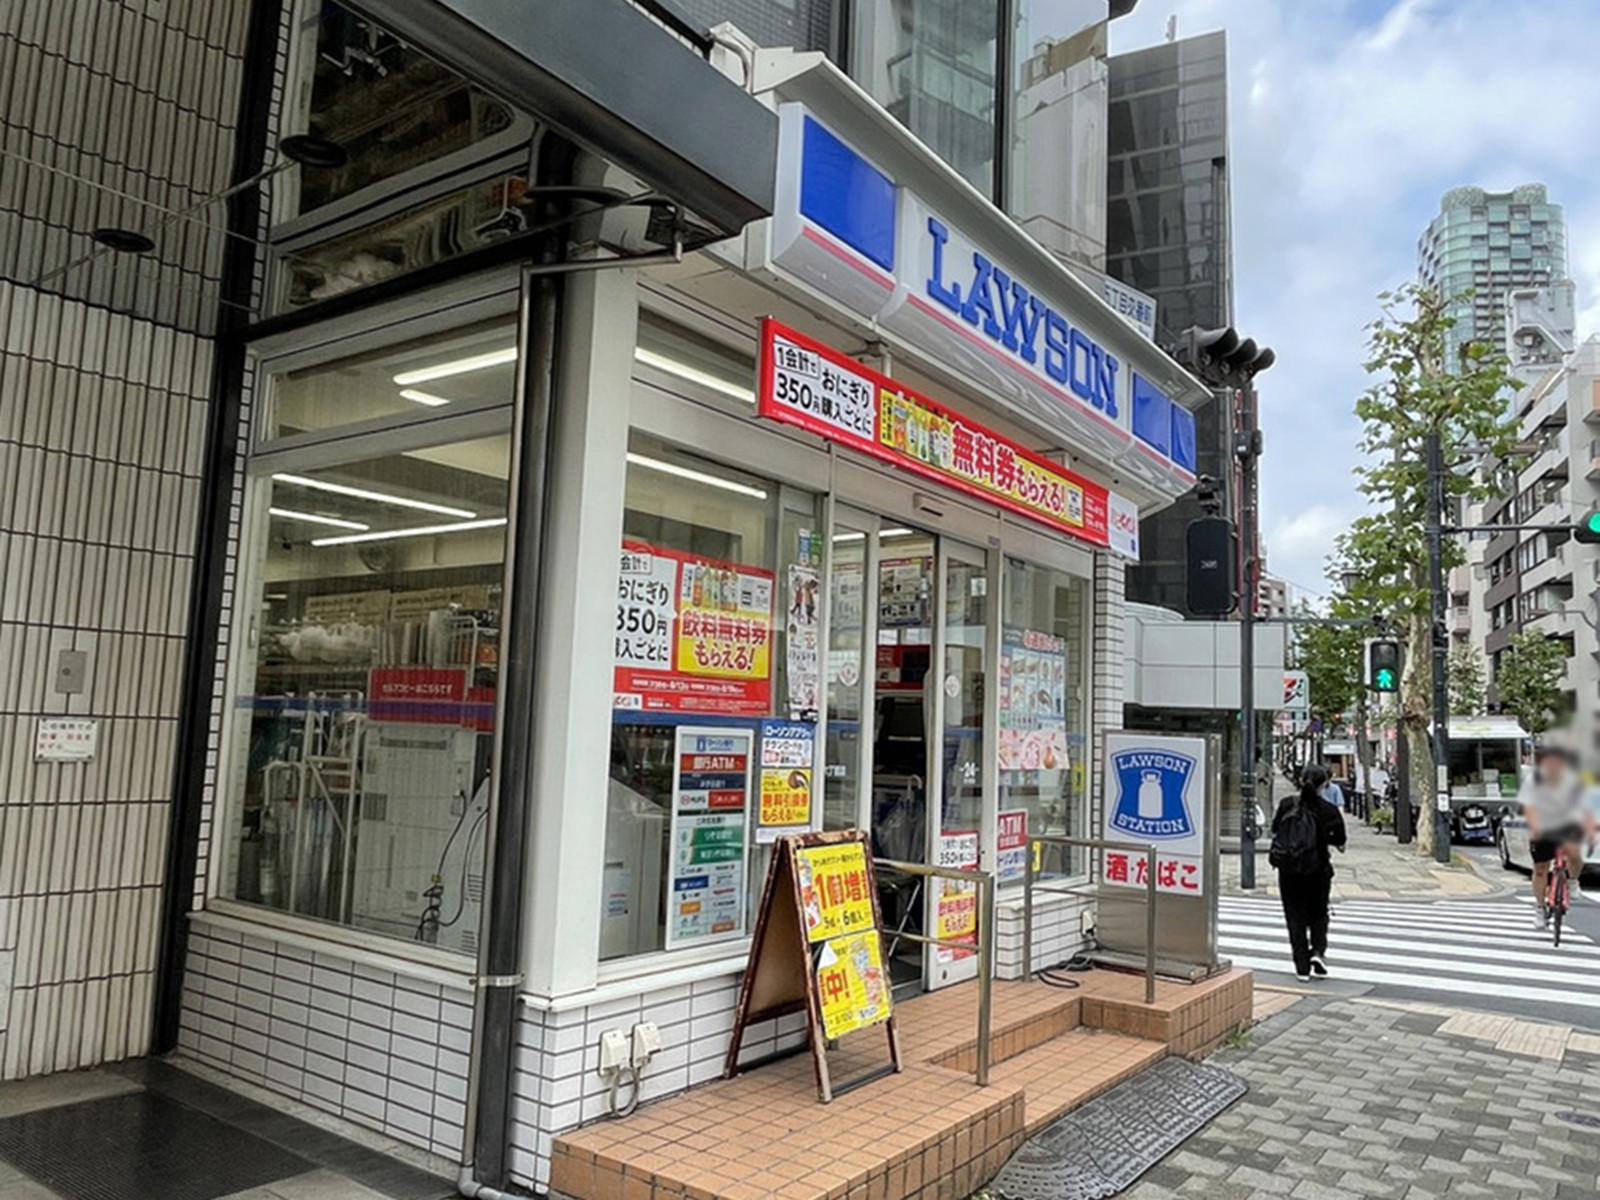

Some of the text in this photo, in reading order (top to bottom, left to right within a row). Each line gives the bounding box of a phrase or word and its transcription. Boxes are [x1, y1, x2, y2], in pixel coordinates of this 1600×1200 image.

[926, 216, 1119, 420] LAWSON
[822, 367, 871, 408] おにぎり
[618, 576, 669, 606] おにぎり
[682, 610, 767, 645] 飲料無料券
[694, 640, 756, 671] もらえる!
[1118, 754, 1188, 774] LAWSON
[1117, 813, 1185, 834] STATION
